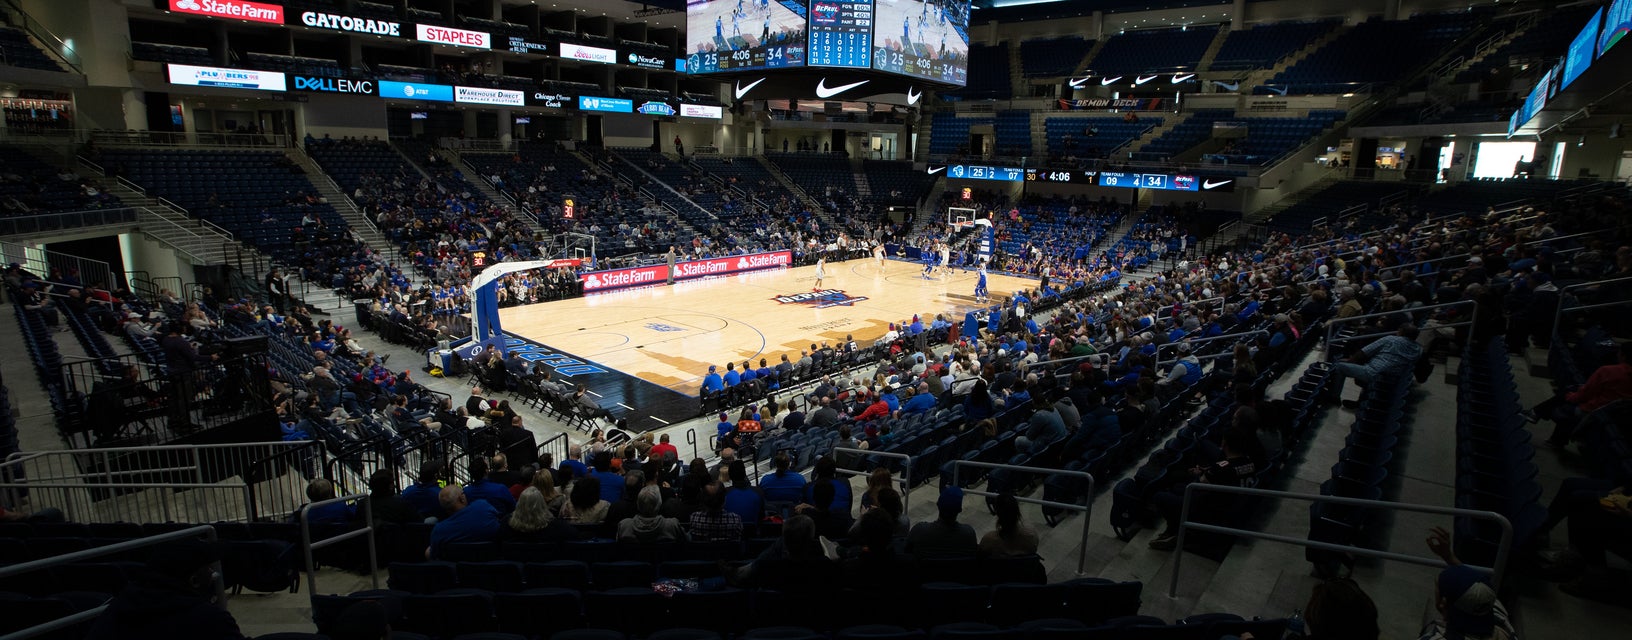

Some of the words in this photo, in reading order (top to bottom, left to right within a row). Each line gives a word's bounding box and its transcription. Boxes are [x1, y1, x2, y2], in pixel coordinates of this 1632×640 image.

[302, 12, 400, 36] GATORADE
[427, 28, 482, 46] STAPLES
[705, 54, 717, 65] 25
[732, 50, 750, 60] 4:06
[768, 48, 782, 60] 34
[892, 53, 904, 65] 25
[917, 58, 931, 69] 4:06
[942, 64, 953, 76] 34
[974, 168, 983, 177] 25
[1050, 172, 1070, 181] 4:06
[1133, 178, 1139, 186] 4
[1148, 177, 1161, 186] 34
[564, 206, 572, 218] 30
